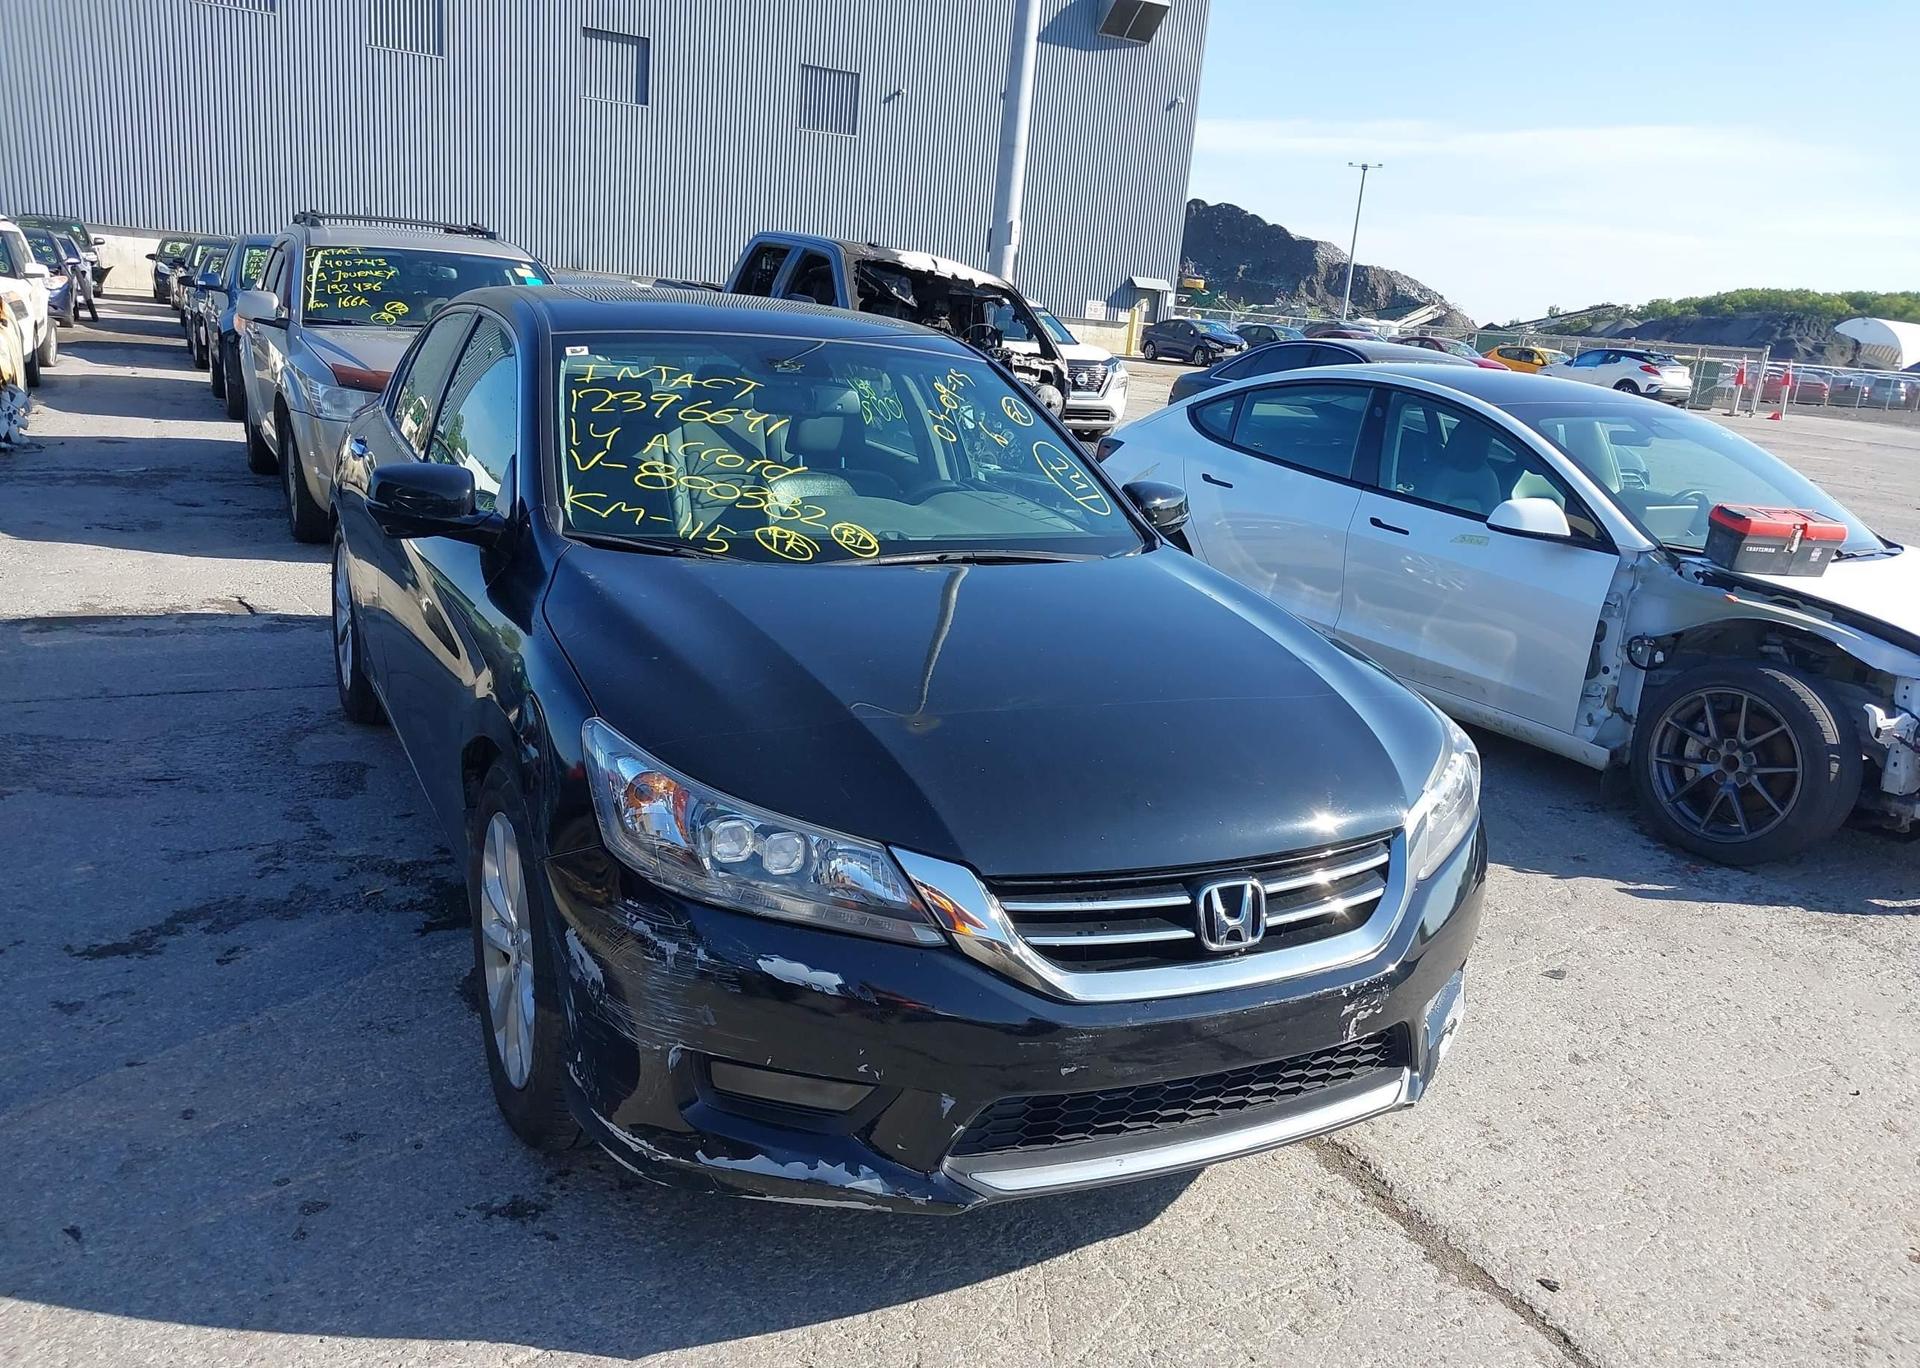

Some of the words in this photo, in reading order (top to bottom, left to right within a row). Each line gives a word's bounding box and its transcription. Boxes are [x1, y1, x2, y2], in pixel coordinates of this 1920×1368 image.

[331, 269, 396, 282] JOURNEY
[572, 364, 765, 400] INTACT
[571, 387, 791, 437] 12396641
